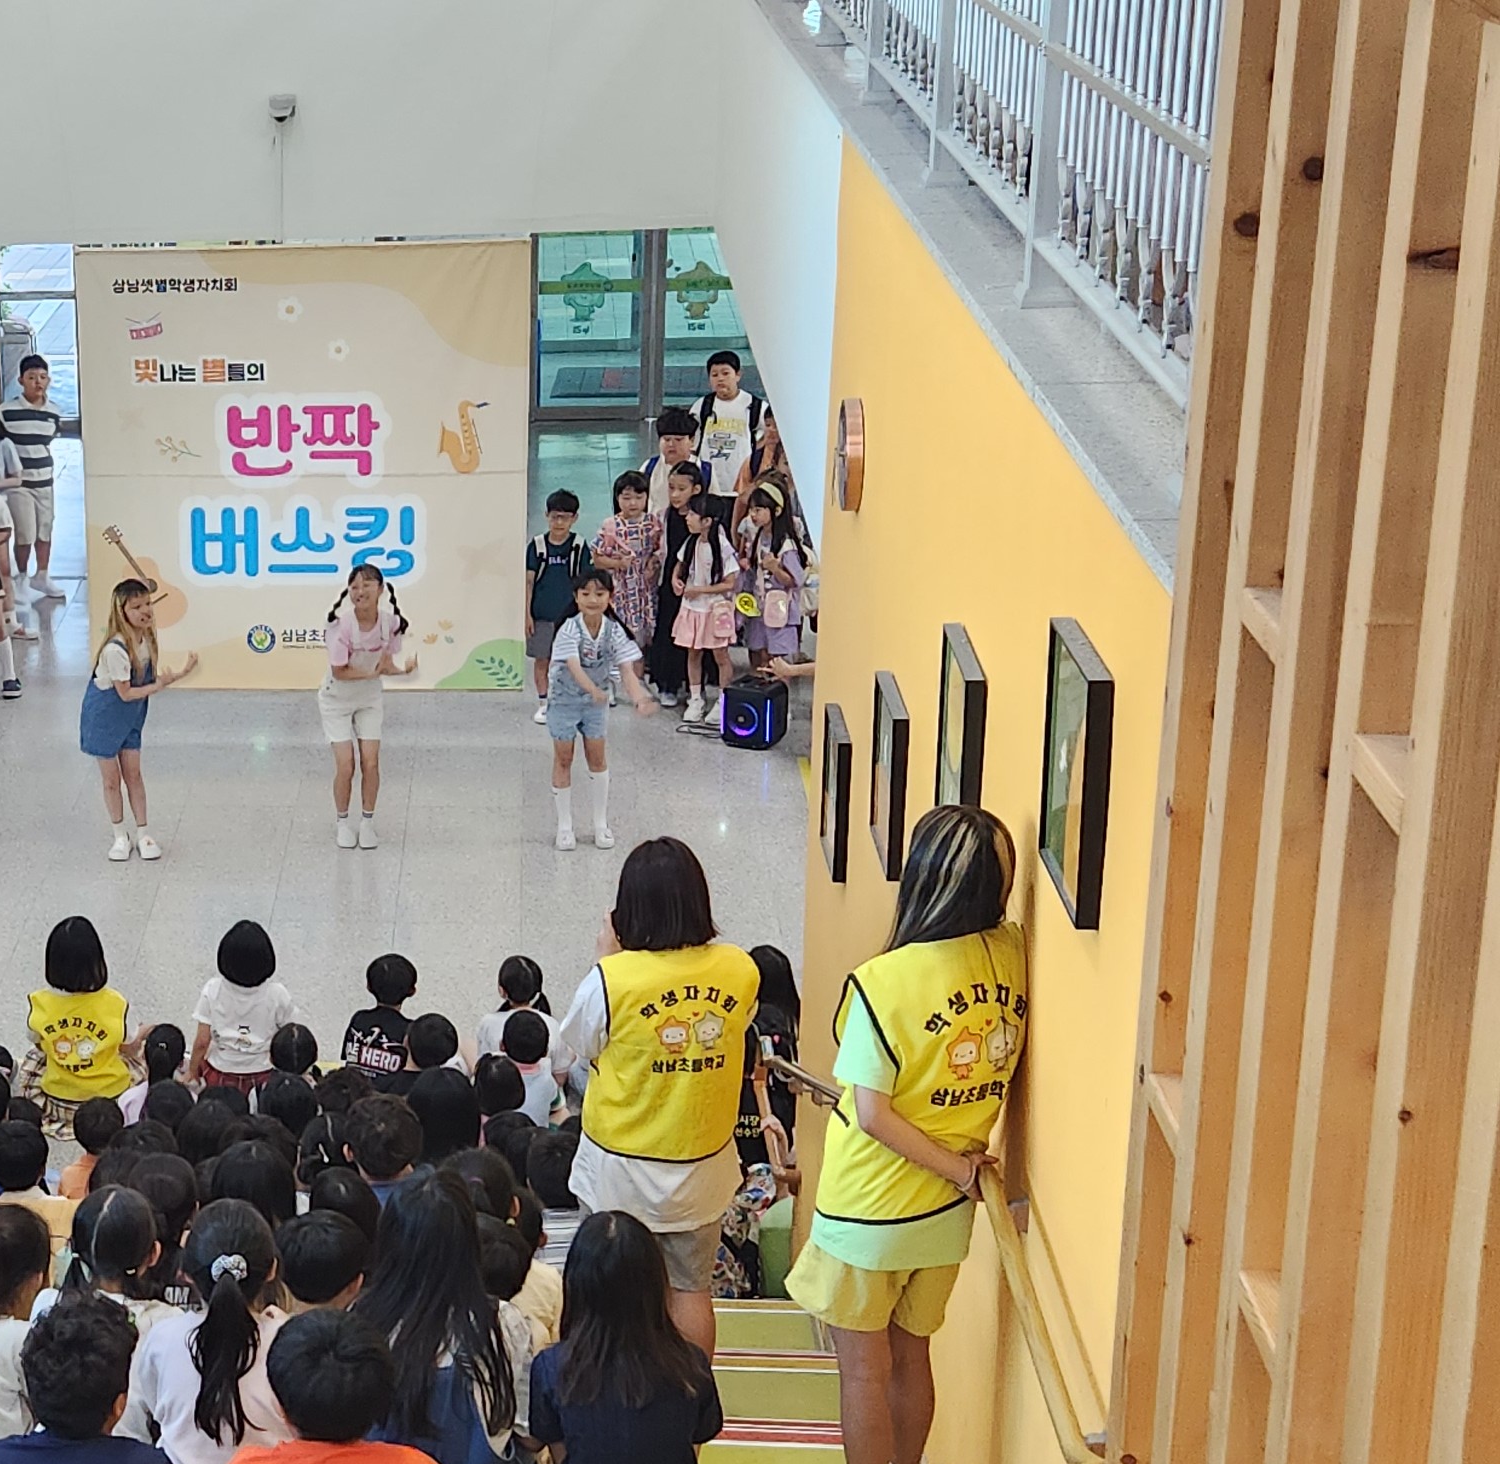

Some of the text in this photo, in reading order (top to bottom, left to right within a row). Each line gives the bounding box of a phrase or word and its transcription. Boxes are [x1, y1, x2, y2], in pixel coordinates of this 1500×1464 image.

[134, 358, 265, 383] 빛나는 별들의
[227, 403, 381, 477] 반짝
[190, 506, 416, 578] 버스킹
[639, 984, 739, 1020] 학생자치회
[923, 982, 1028, 1036] 학생자치회
[360, 1044, 401, 1073] HERO
[651, 1053, 726, 1074] 상남초등학교
[930, 1079, 1012, 1107] 상남초등학
